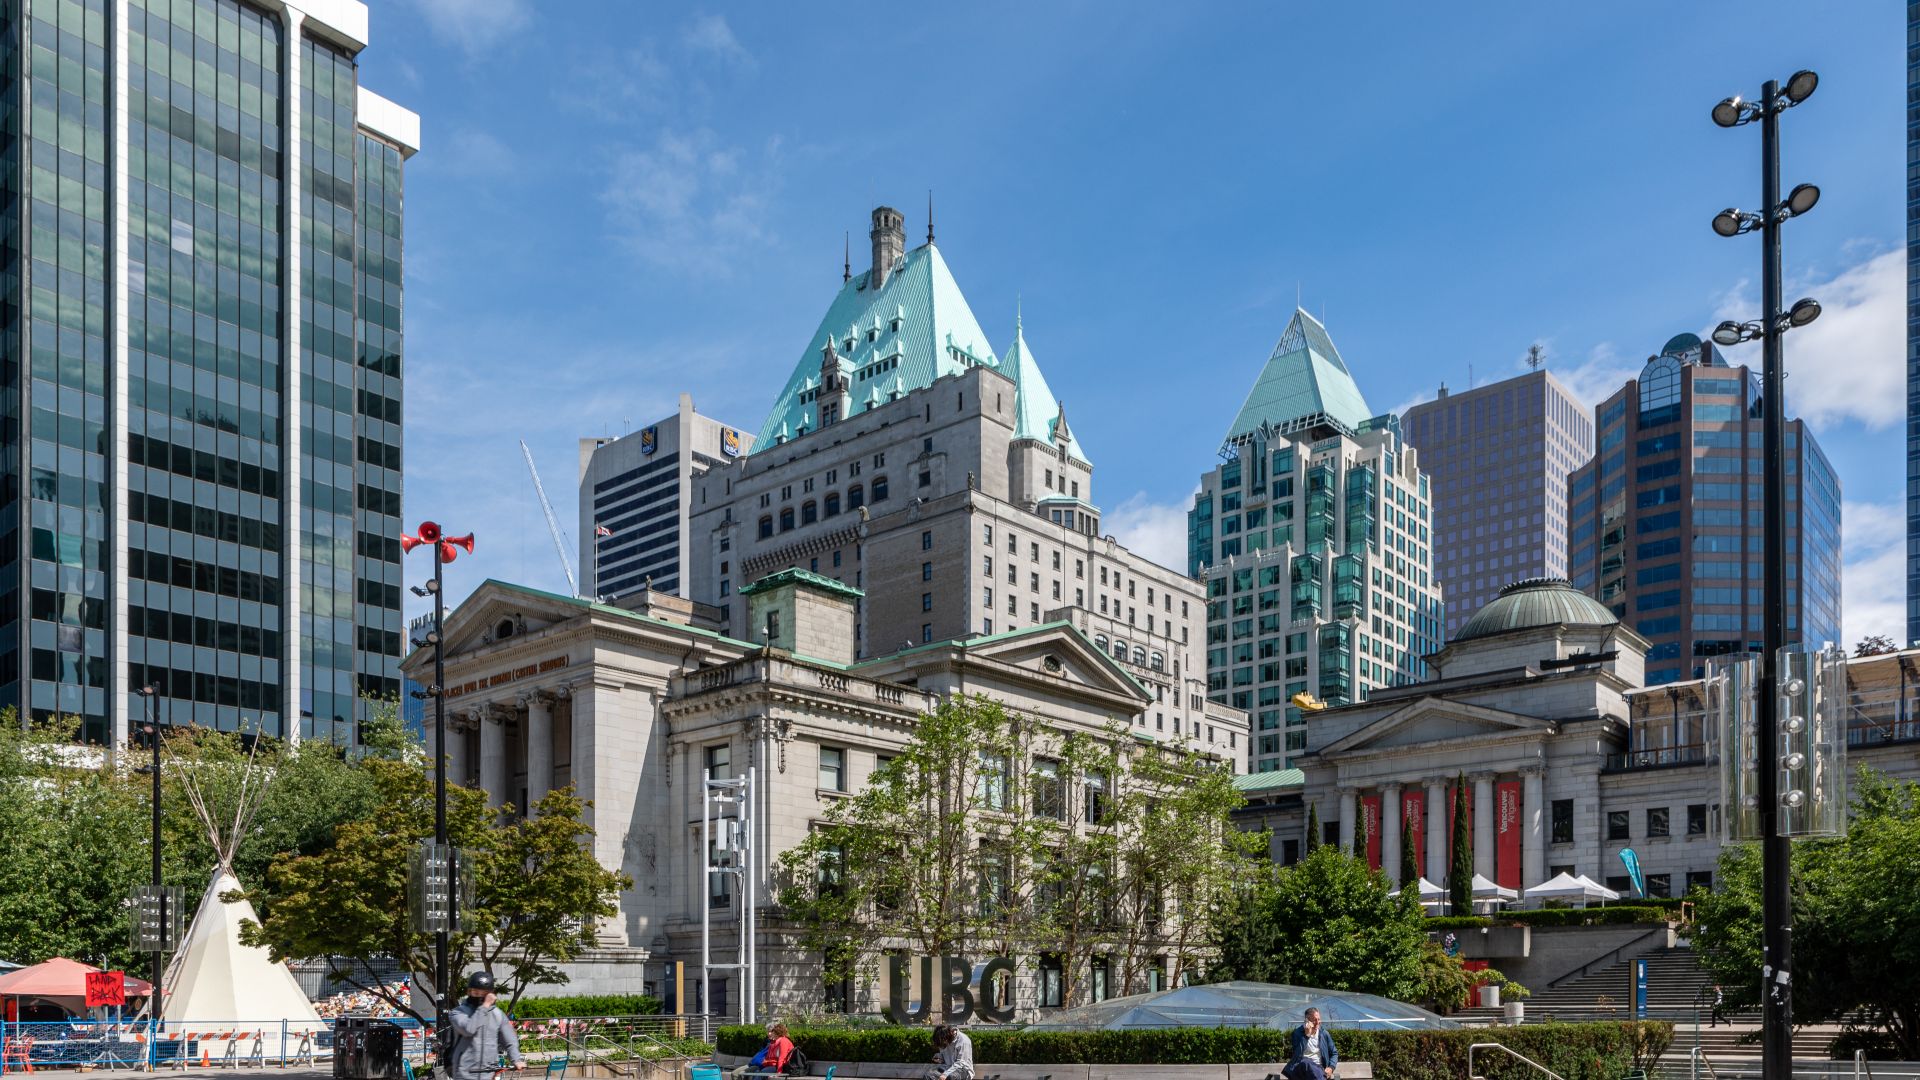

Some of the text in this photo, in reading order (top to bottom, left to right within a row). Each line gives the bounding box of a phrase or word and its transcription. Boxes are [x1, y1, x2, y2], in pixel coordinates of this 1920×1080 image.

[725, 444, 738, 454] RBC
[1500, 790, 1508, 833] Vancouver
[89, 974, 117, 987] LAND
[91, 985, 122, 1003] BACK
[881, 955, 1016, 1026] UBC
